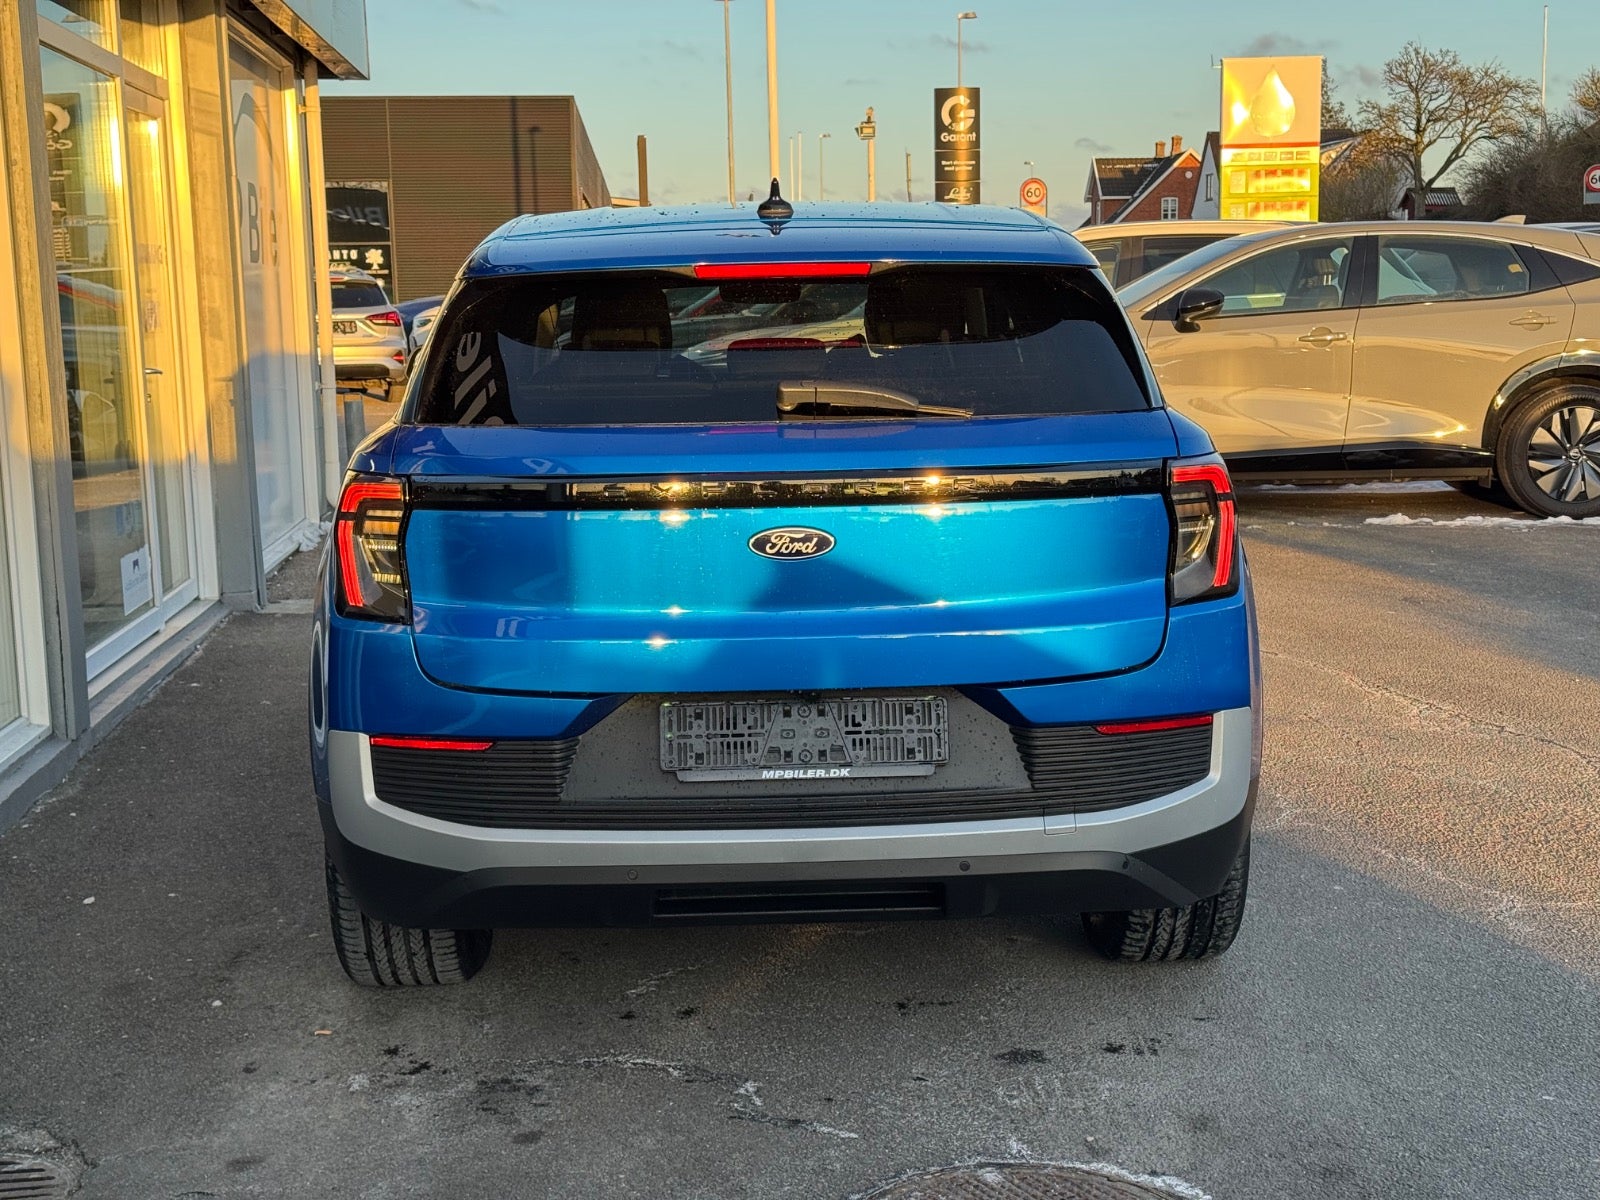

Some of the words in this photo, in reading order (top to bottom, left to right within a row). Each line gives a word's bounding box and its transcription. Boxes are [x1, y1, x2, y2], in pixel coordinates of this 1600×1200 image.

[941, 133, 976, 143] Garant
[1026, 187, 1041, 198] 60
[765, 532, 817, 554] Ford
[761, 768, 851, 780] MPBILER.DK
